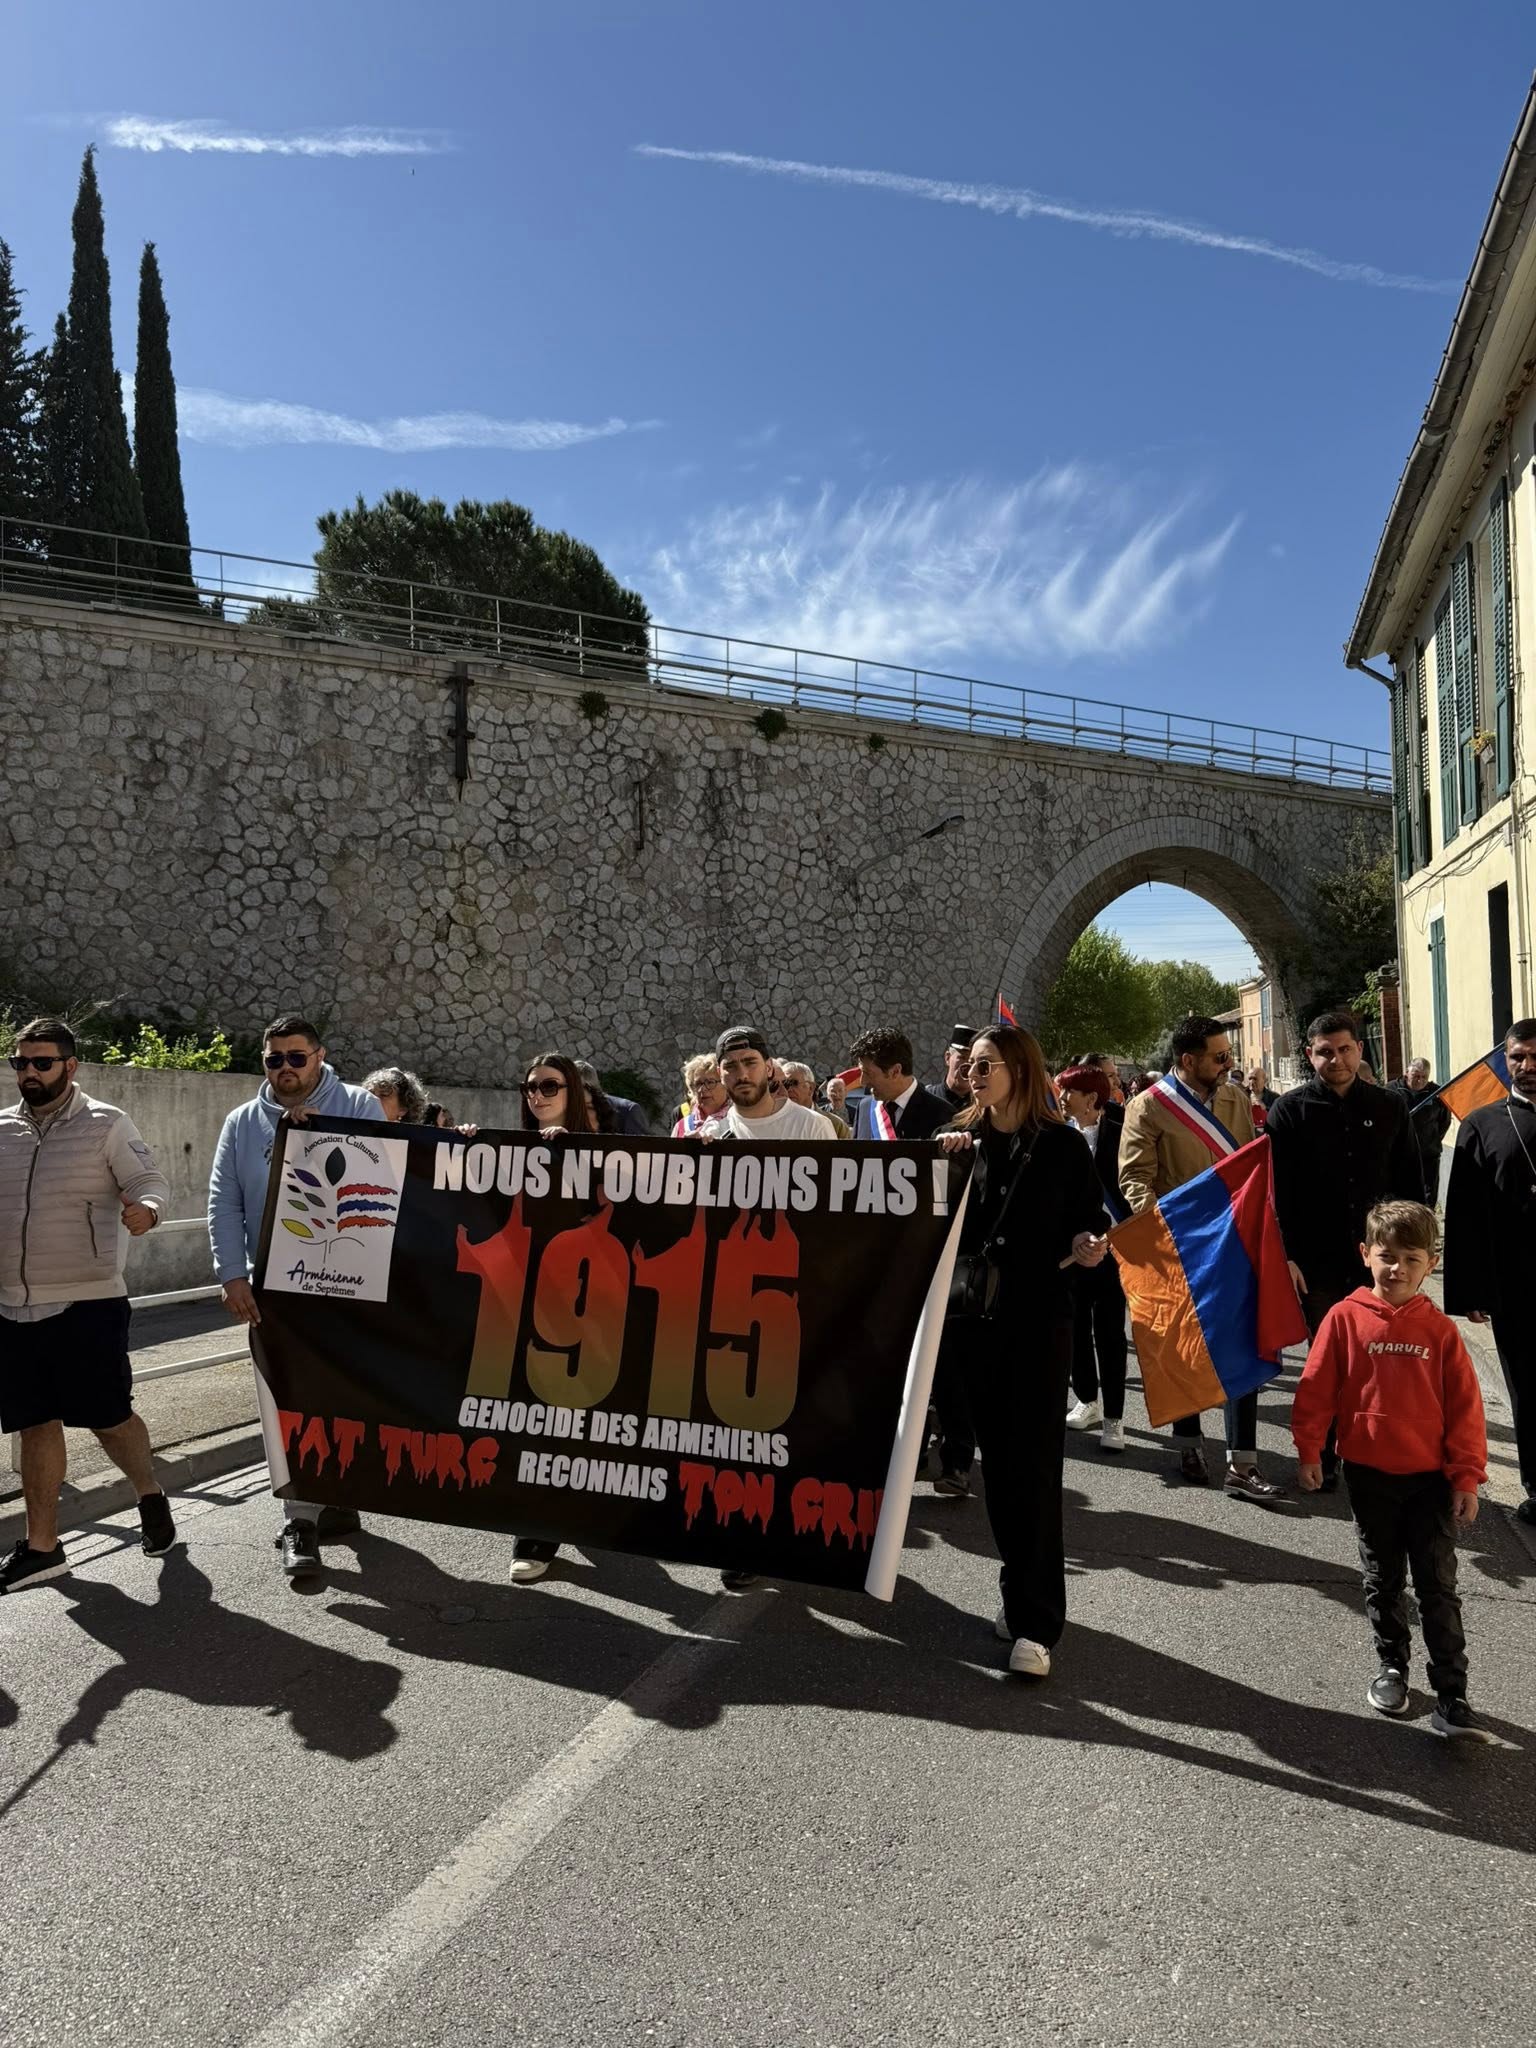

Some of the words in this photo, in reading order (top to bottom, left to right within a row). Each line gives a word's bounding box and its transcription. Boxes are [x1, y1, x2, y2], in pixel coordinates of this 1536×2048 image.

[303, 1135, 343, 1158] Association
[346, 1135, 380, 1165] Culturelle
[433, 1141, 551, 1198] NOUS
[561, 1149, 819, 1212] N'OUBLIONS
[829, 1157, 918, 1216] PAS
[931, 1159, 950, 1216] !
[287, 1259, 364, 1285] Arménienne
[302, 1282, 314, 1292] de
[315, 1281, 356, 1297] Septèmes
[456, 1187, 801, 1432] 1915
[1368, 1341, 1430, 1360] MARVEL
[458, 1396, 587, 1440] GENOCIDE
[589, 1411, 639, 1447] DES
[641, 1416, 790, 1467] ARMENIENS
[379, 1424, 500, 1492] TURC
[517, 1450, 669, 1502] RECONNAIS
[679, 1460, 775, 1535] TON
[791, 1477, 885, 1551] CRI
